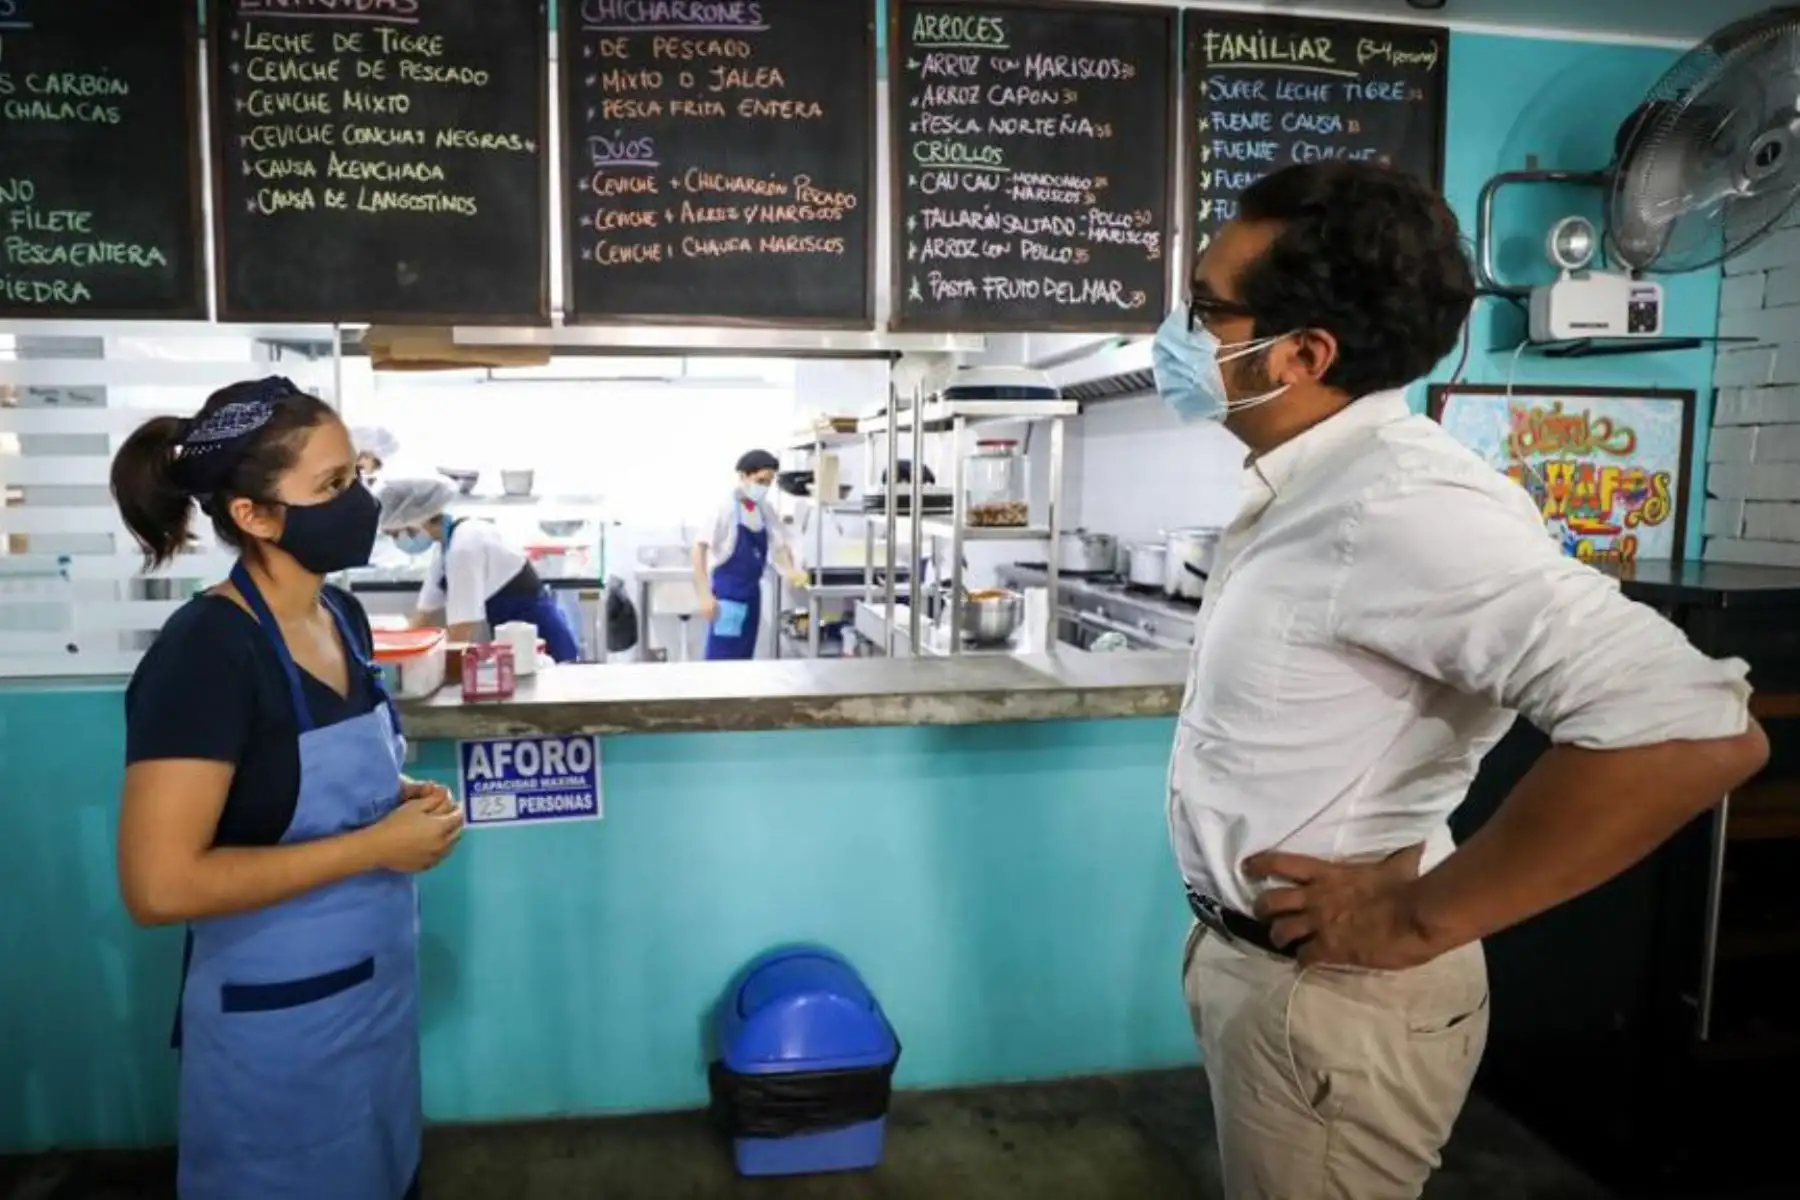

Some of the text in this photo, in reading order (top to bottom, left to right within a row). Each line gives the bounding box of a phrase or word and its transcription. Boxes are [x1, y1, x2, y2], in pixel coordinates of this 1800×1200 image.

[581, 0, 765, 24] CHICHARRONES
[244, 22, 443, 57] LECHE DE TIGRE
[912, 13, 1006, 43] ARROCES
[600, 36, 751, 60] DE PESCADO
[1203, 29, 1336, 64] FAMILIAR
[247, 56, 489, 86] CEVICHE DE PESCADO
[602, 69, 663, 92] MIXTO
[708, 65, 785, 92] JALEA
[921, 53, 980, 80] ARROZ
[1025, 52, 1120, 82] MARISCOS
[248, 89, 410, 117] CEVICHE MIXTO
[921, 84, 981, 109] ARROZ
[986, 84, 1059, 106] CAPON
[1208, 76, 1269, 102] SUPER
[1275, 79, 1333, 102] LECHE
[1342, 80, 1407, 103] TIGRE
[4, 100, 120, 124] CHALACAS
[603, 94, 824, 121] PESCA FRITA ENTERA
[921, 113, 981, 135] PESCA
[988, 113, 1094, 139] NORTEÑA
[1210, 110, 1273, 132] FUENTE
[1281, 112, 1344, 135] CAUSA
[250, 124, 335, 150] CEVICHE
[436, 128, 522, 150] NEGRAS
[1212, 139, 1280, 162] FUENTE
[912, 140, 1003, 164] CRIOLLOS
[255, 158, 317, 179] CAUSA
[592, 170, 659, 196] CEVICHE
[793, 173, 857, 210] PESCADO
[919, 173, 959, 195] CAU
[961, 174, 1001, 192] CAU
[257, 186, 478, 216] CAUSA DE LANGOSTINOS
[594, 208, 657, 231] CEVICHE
[680, 200, 740, 224] ARROZ
[1002, 213, 1076, 237] SALTADO
[1087, 207, 1133, 229] POLLO
[595, 240, 663, 266] CEVICHE
[758, 234, 845, 254] MARISCOS
[920, 238, 980, 263] ARROZ
[1020, 239, 1073, 264] POLLO
[928, 270, 978, 300] PASTA
[466, 738, 593, 780] AFORO
[518, 794, 593, 814] PERSONAS
